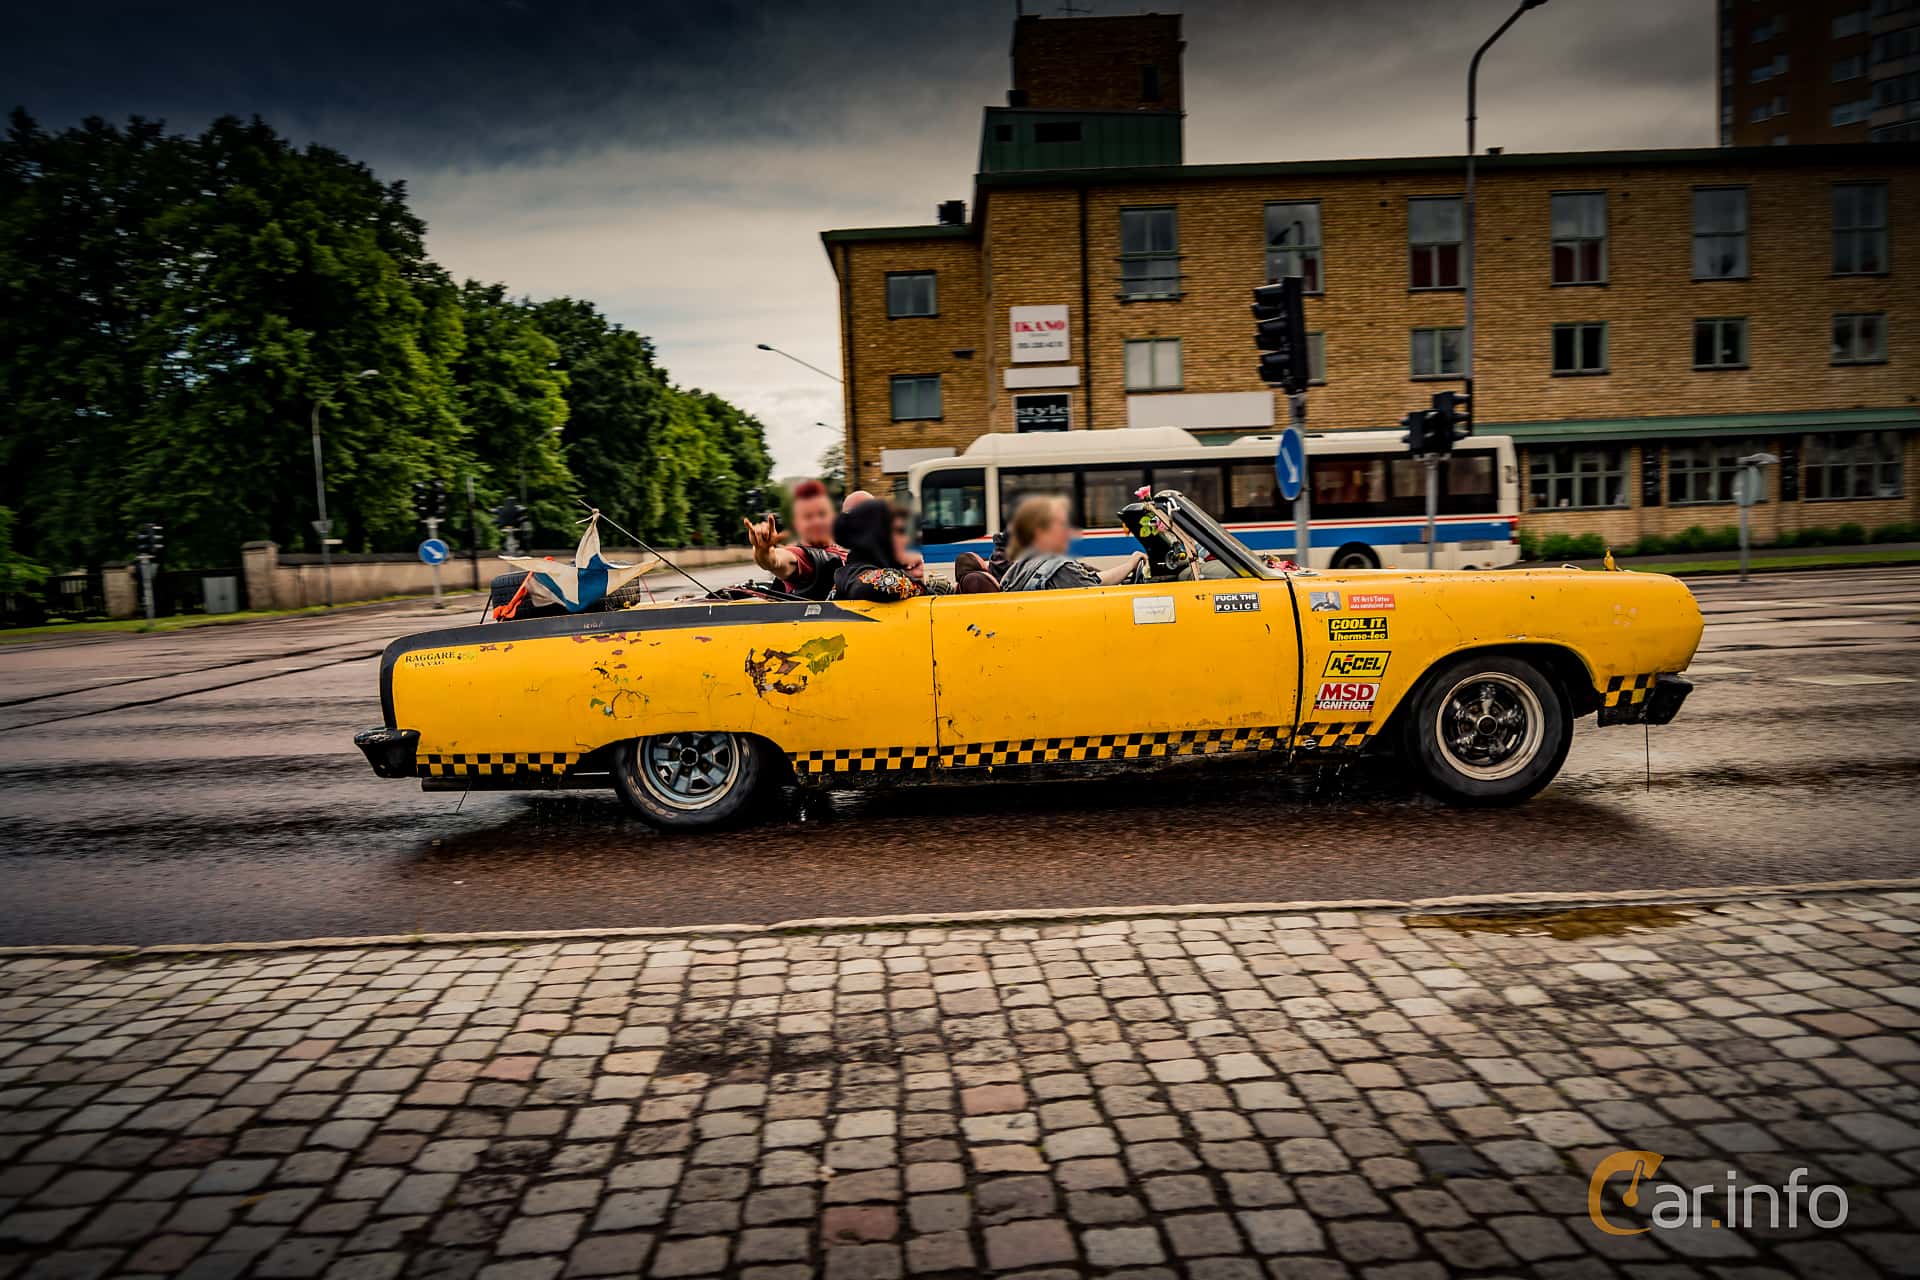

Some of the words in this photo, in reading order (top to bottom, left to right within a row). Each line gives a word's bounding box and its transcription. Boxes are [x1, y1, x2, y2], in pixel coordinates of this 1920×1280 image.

[1216, 602, 1259, 610] POLICE
[1331, 619, 1367, 629] COOL
[405, 651, 455, 663] RAGGARE
[1330, 655, 1381, 674] ACCEL
[1321, 684, 1374, 700] MSD
[1319, 700, 1369, 710] IGNITION
